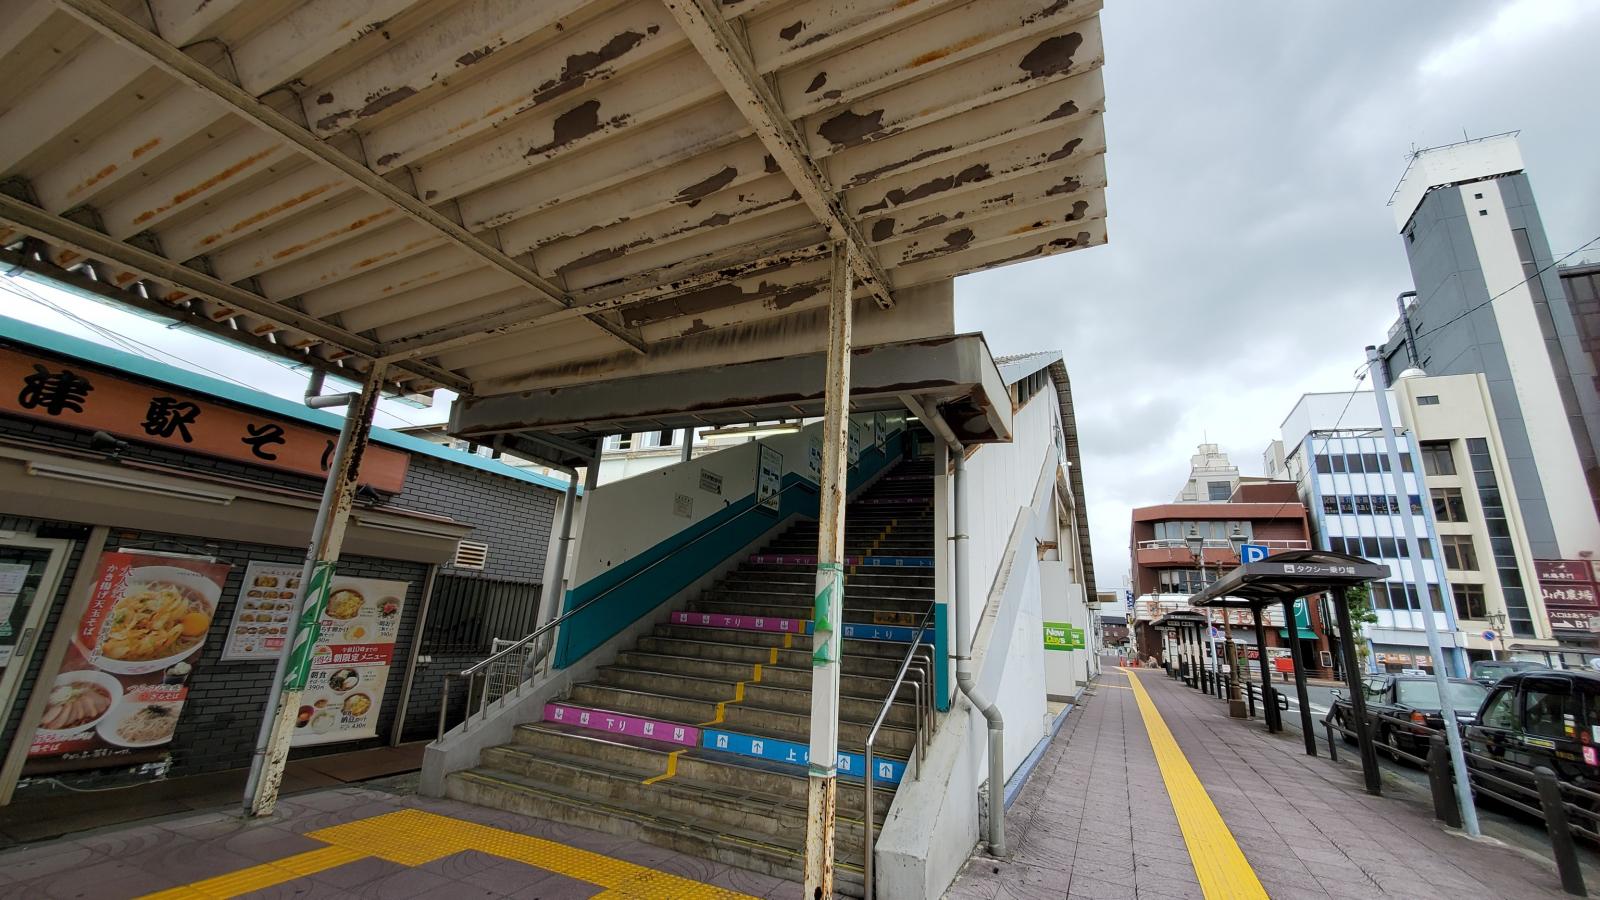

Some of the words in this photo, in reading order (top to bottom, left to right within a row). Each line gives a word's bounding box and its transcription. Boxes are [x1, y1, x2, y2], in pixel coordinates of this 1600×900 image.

[1248, 547, 1264, 562] P
[1296, 565, 1356, 574] タクシー乗り場
[1543, 589, 1593, 600] 山内農場
[723, 617, 742, 627] 下り
[1575, 620, 1589, 628] B1
[871, 629, 894, 640] 上り
[1046, 628, 1065, 637] New
[1046, 636, 1066, 645] Days
[606, 717, 626, 732] 下り
